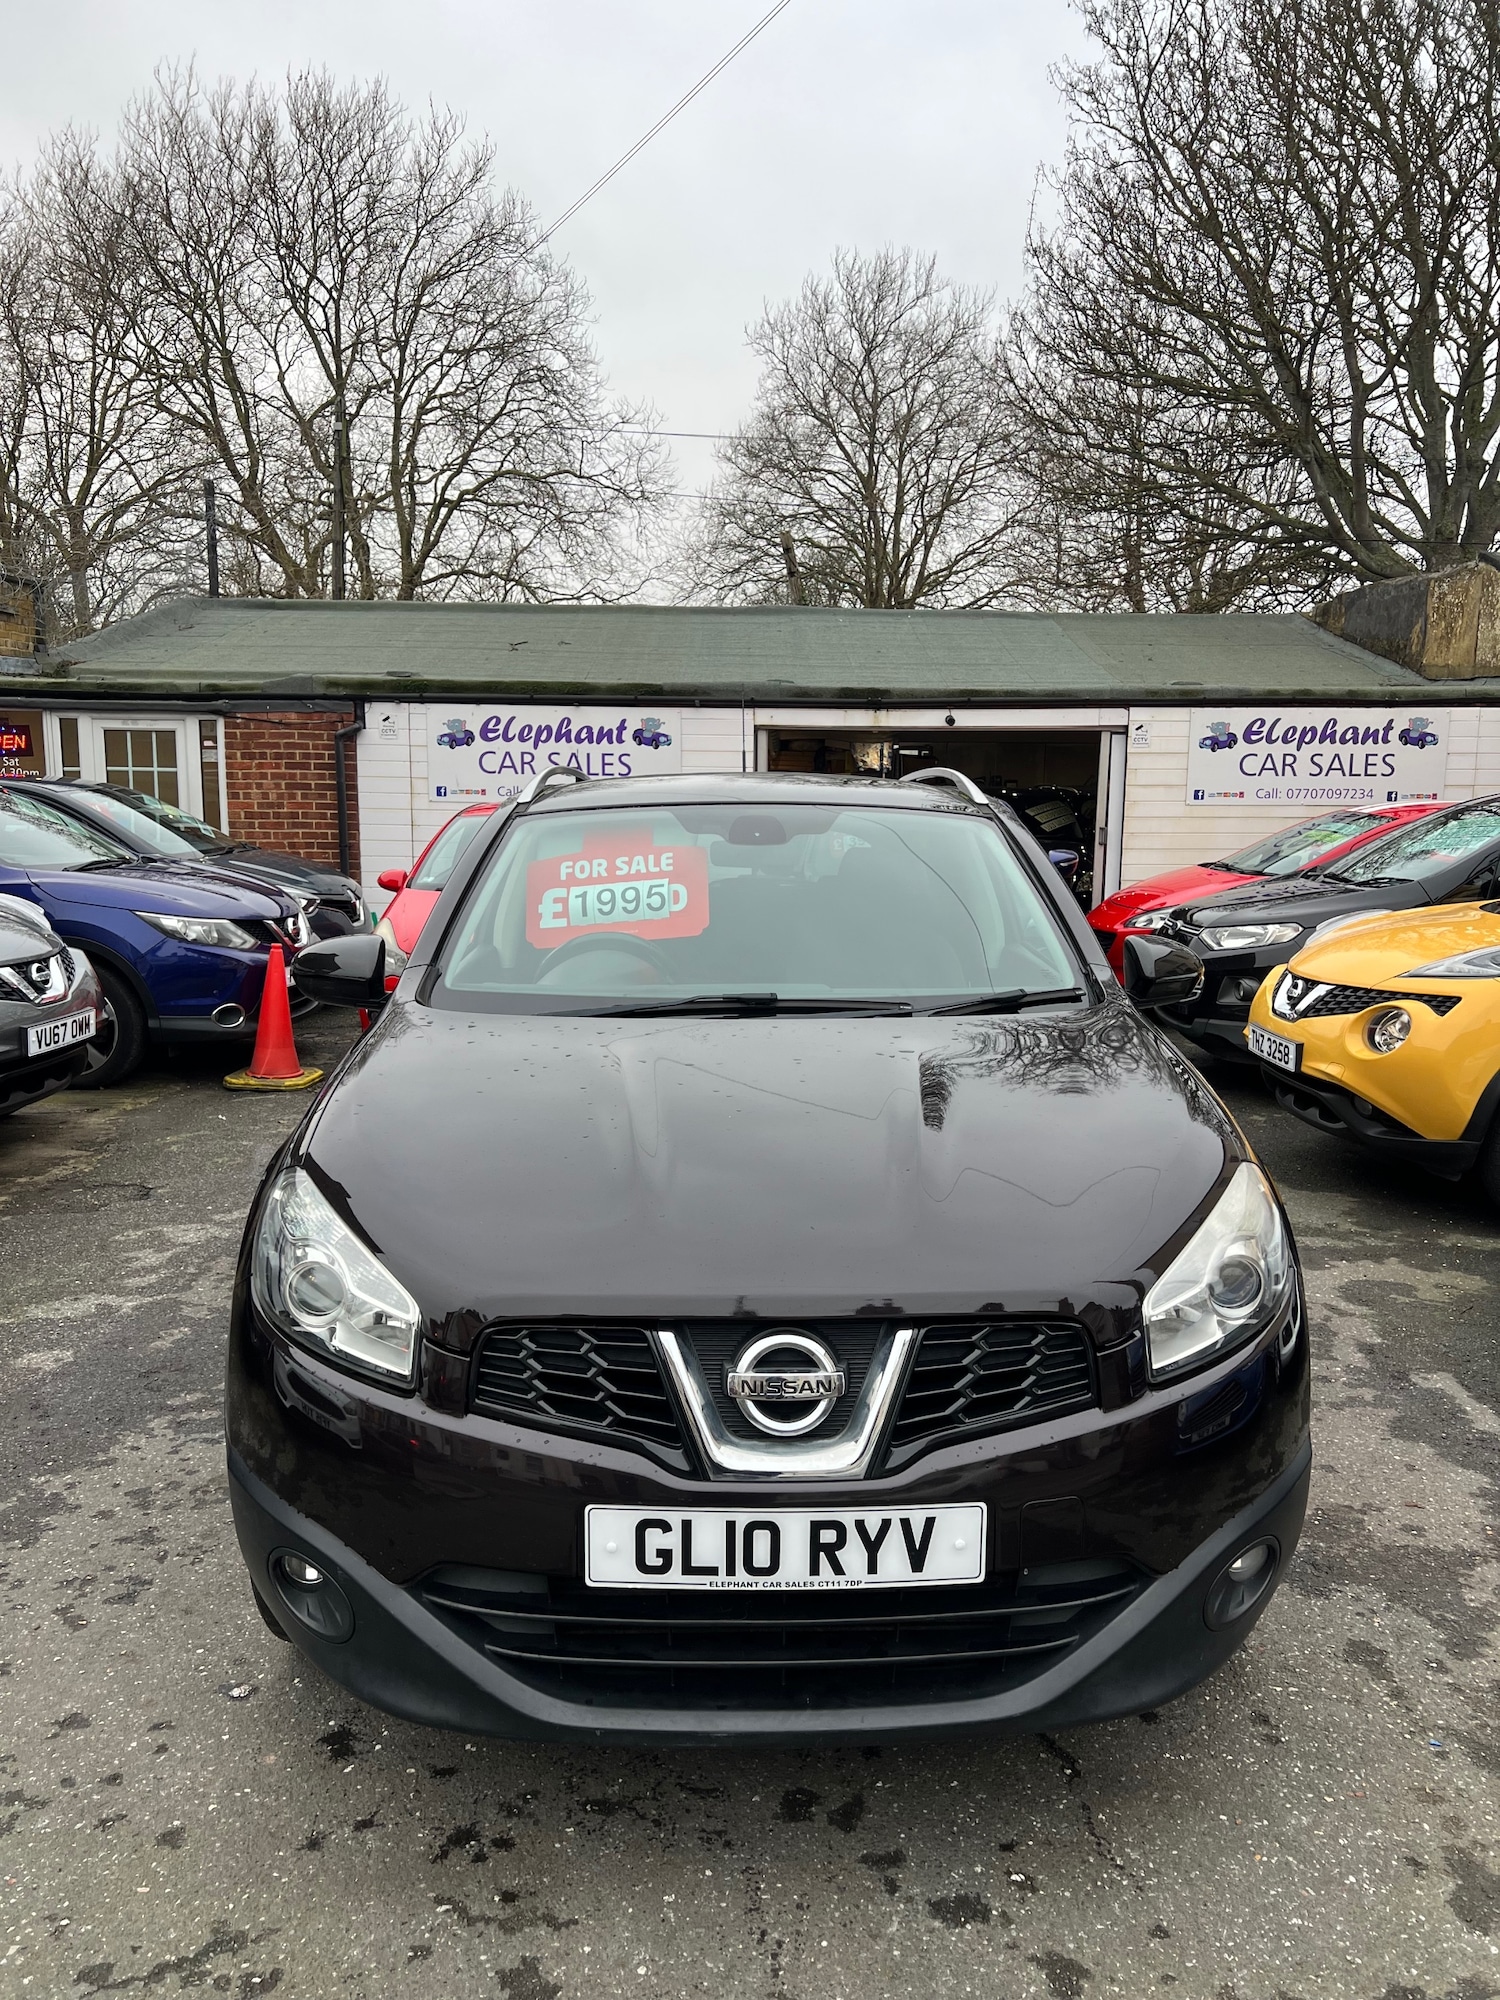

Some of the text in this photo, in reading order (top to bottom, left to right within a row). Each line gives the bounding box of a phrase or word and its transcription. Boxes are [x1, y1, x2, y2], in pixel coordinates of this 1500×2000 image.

[0, 735, 26, 749] EN
[479, 715, 628, 750] Elephant
[1242, 717, 1395, 752] Elephant
[2, 756, 20, 766] Sat
[478, 751, 632, 777] CAR SALES
[1239, 753, 1395, 777] CAR SALES
[1255, 788, 1282, 799] Call:
[1286, 788, 1374, 800] 07707097234
[560, 852, 674, 881] FOR SALE
[36, 1022, 68, 1050] VU67
[1252, 1028, 1290, 1065] THZ 3258
[741, 1379, 832, 1395] NISSAN
[809, 1516, 937, 1577] RYV
[709, 1580, 760, 1588] ELEPHANT
[762, 1580, 782, 1588] CAR
[785, 1580, 815, 1588] SALES
[844, 1579, 863, 1587] 7DP
